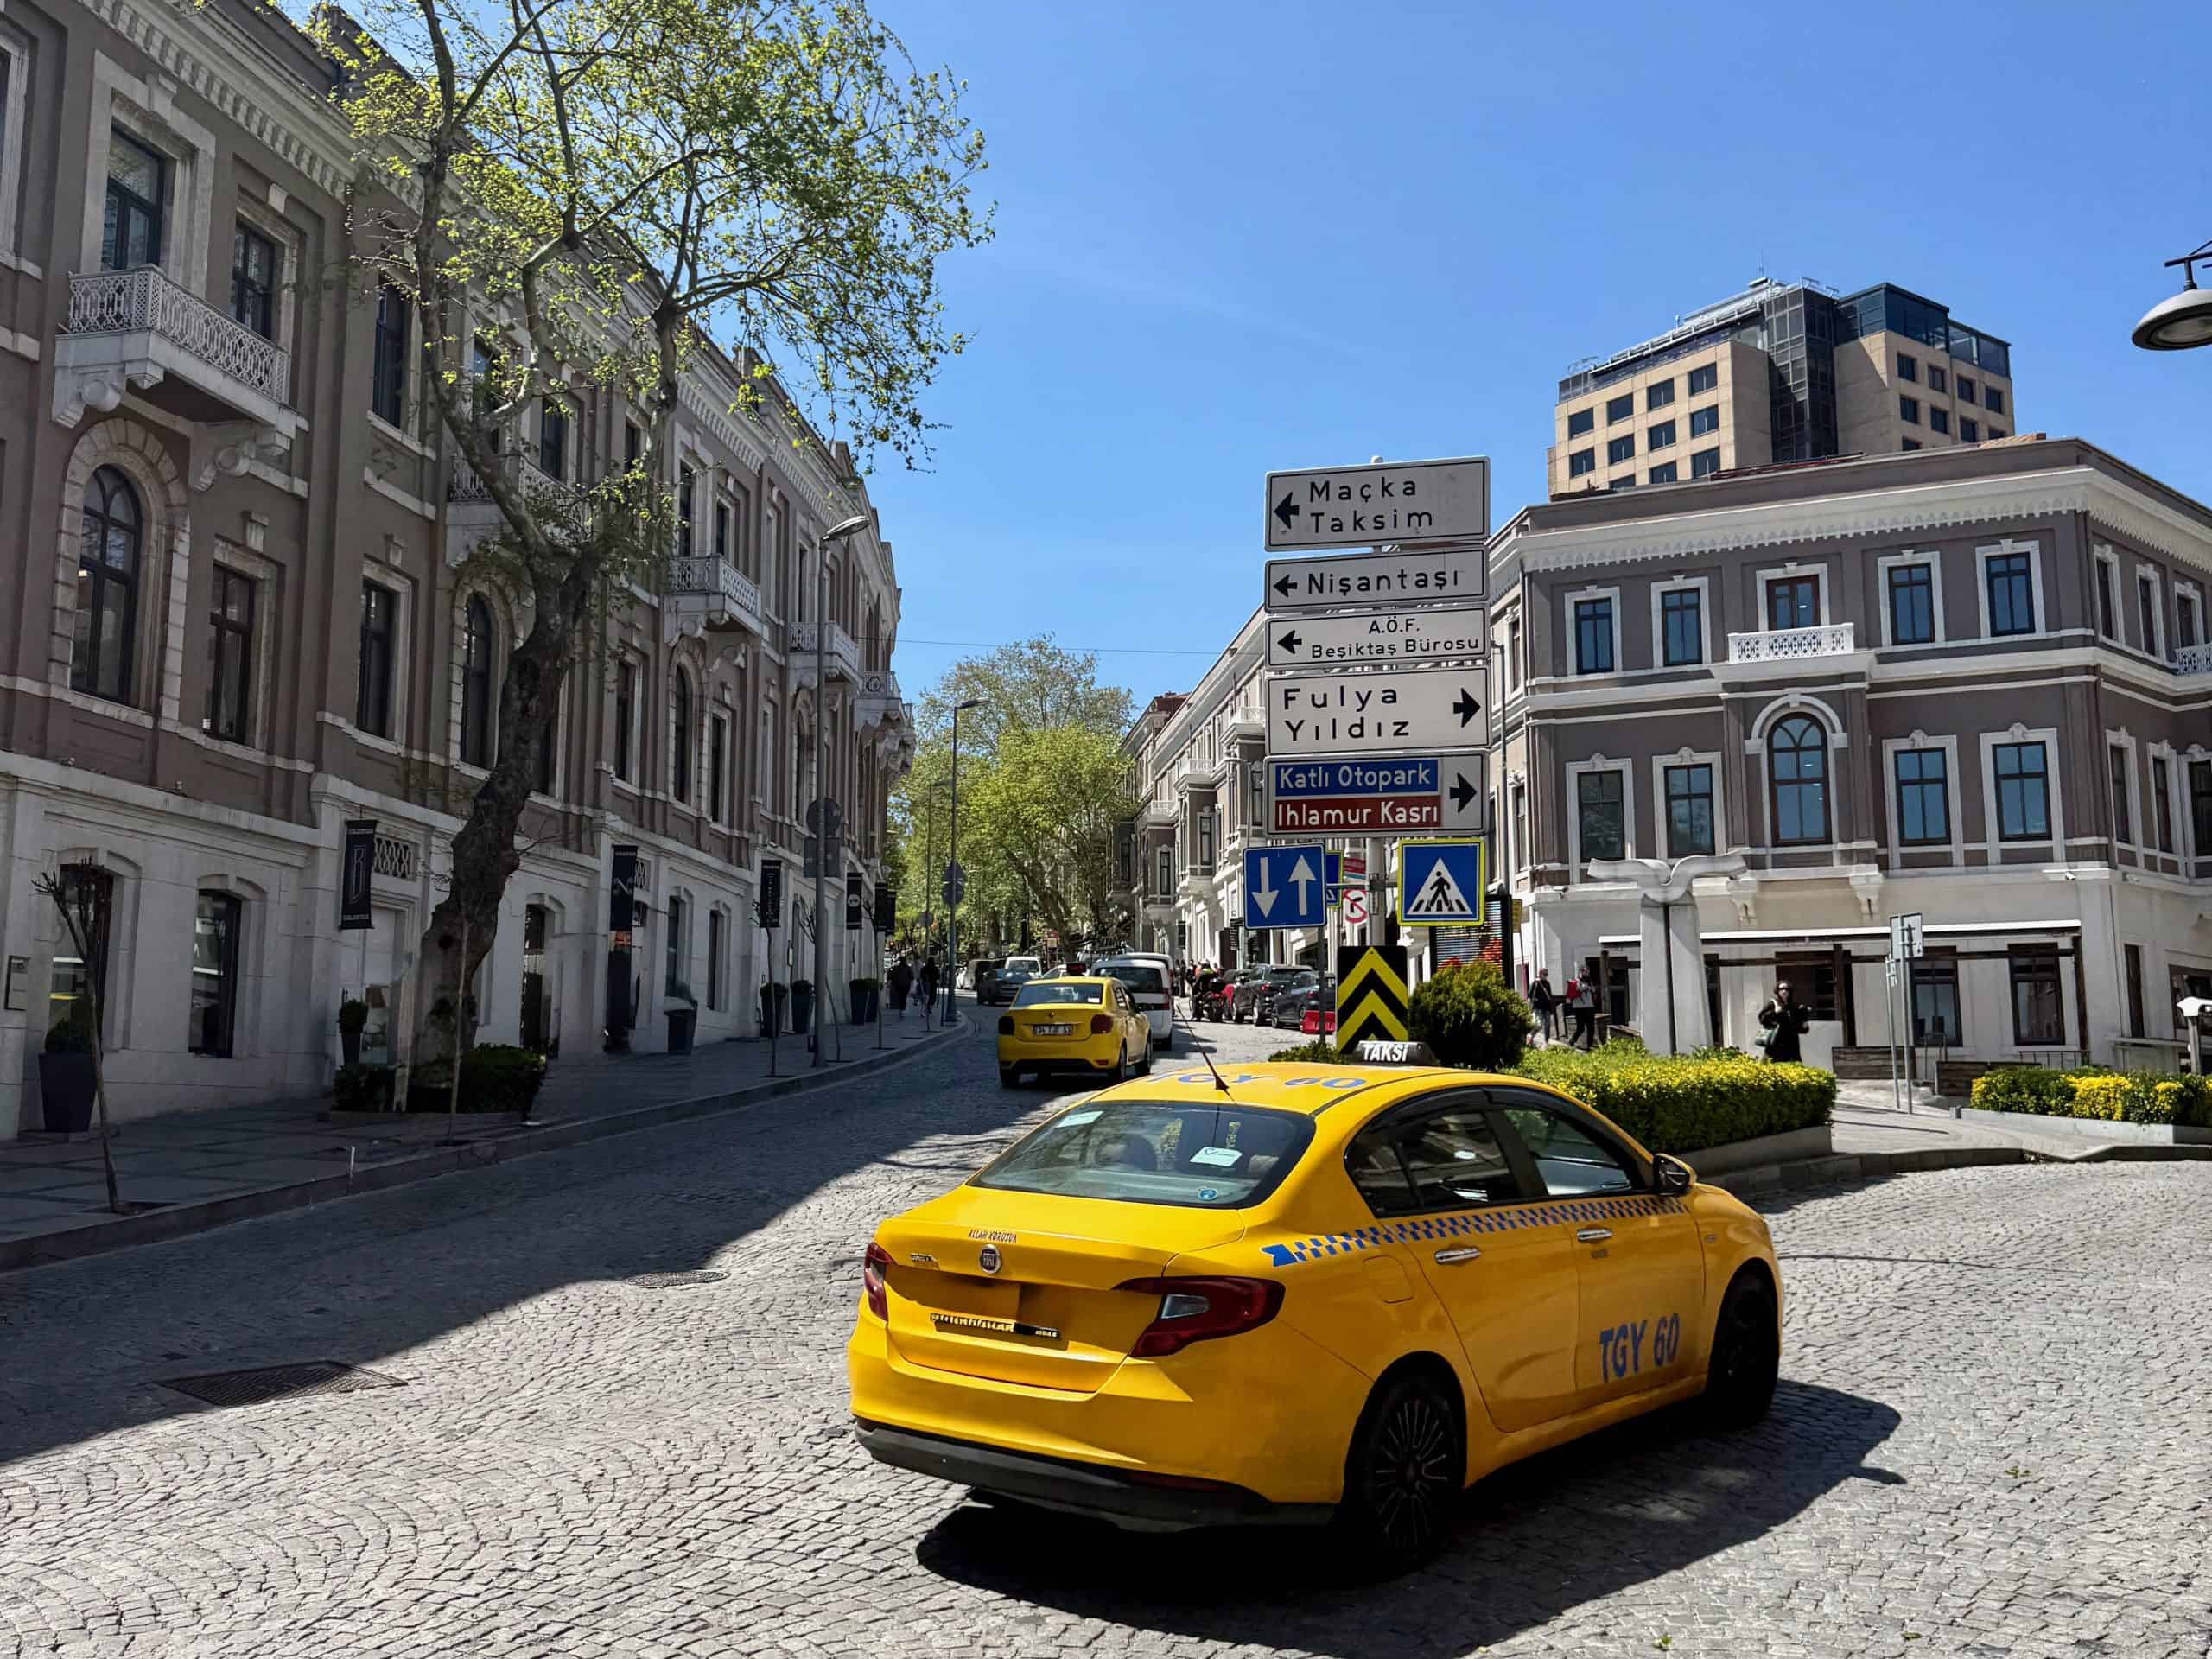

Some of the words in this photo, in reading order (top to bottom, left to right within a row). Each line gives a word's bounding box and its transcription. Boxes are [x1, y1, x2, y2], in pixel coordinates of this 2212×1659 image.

[1309, 477, 1417, 503] Maçka
[1310, 509, 1433, 534] Taksim
[1307, 569, 1459, 595] Nişantaşı
[1368, 616, 1421, 635] A.Ö.F.
[1311, 641, 1397, 659] Beşiktaş
[1405, 637, 1480, 653] Bürosu
[1283, 685, 1398, 712] Fulya
[1284, 717, 1410, 741] Yıldız
[1280, 767, 1329, 789] Katlı
[1338, 763, 1431, 792] Otopark
[1278, 803, 1372, 827] Ihlamur
[1381, 801, 1439, 823] Kasrı
[1599, 1319, 1648, 1382] TGY
[1653, 1313, 1681, 1368] 60
